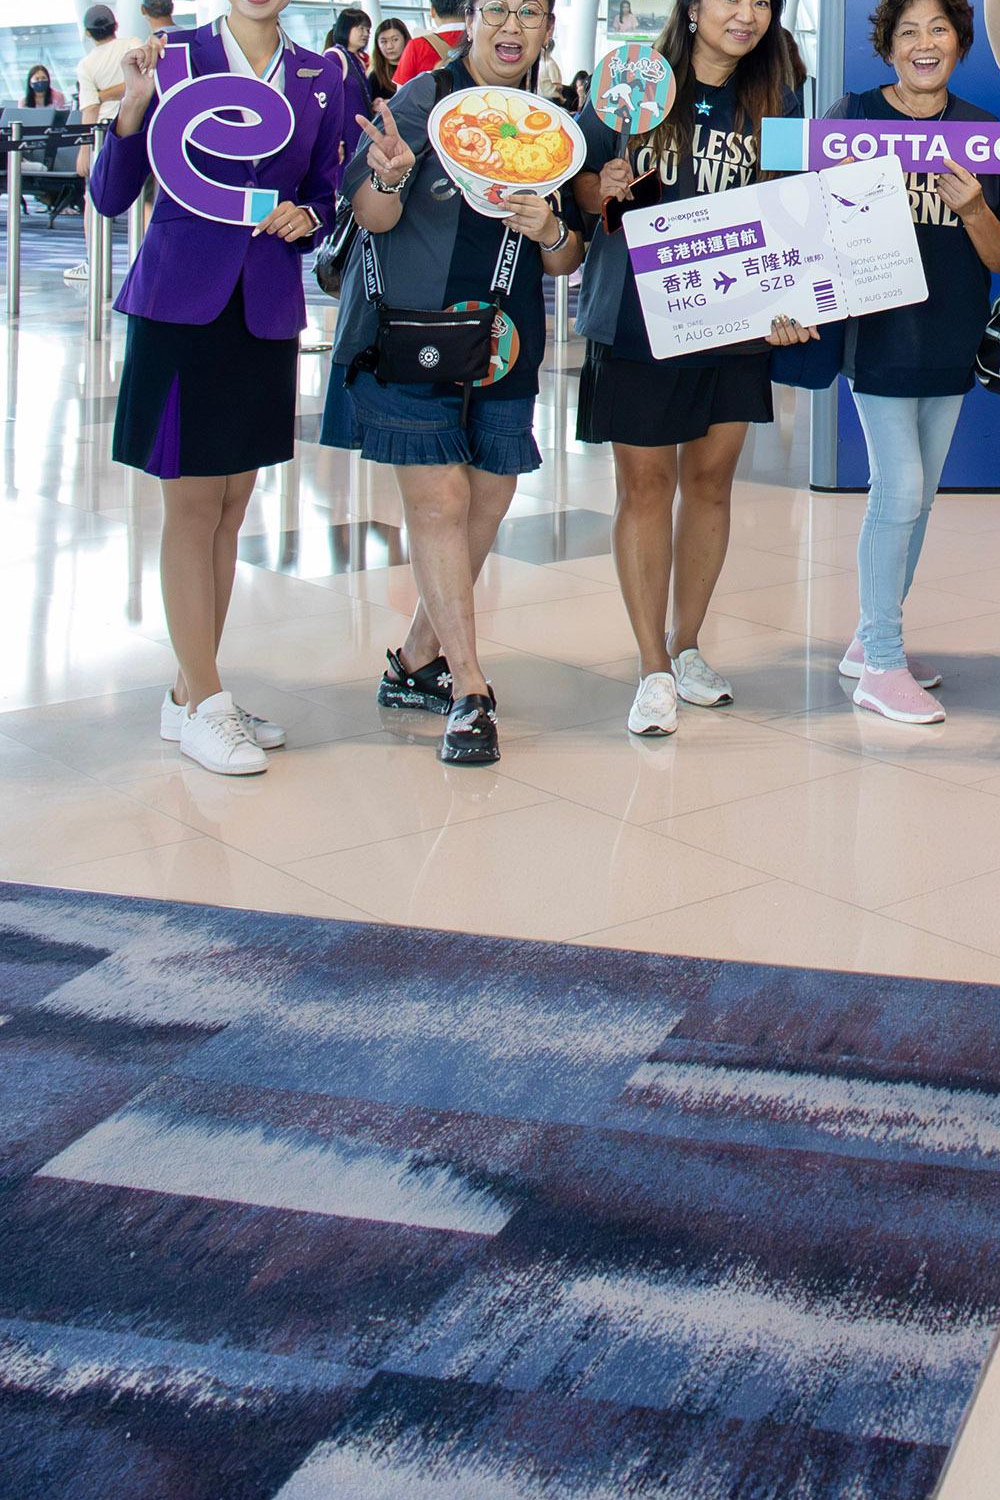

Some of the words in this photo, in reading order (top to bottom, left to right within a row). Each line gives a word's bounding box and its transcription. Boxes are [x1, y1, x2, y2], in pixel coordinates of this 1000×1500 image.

[822, 132, 951, 162] GOTTA
[656, 228, 758, 264] 香港快運首航
[846, 237, 872, 248] UO716
[497, 239, 517, 289] KIPLING
[850, 256, 876, 266] HONG
[877, 250, 900, 261] KONG
[853, 265, 879, 275] KUALA
[880, 257, 914, 270] LUMPUR
[365, 248, 377, 295] KIPLING
[662, 269, 702, 294] 香港
[741, 247, 802, 277] 吉隆坡
[855, 272, 893, 285] (SUBANG)
[759, 274, 796, 293] SZB
[667, 293, 707, 313] HKG
[864, 293, 881, 302] AUG
[883, 288, 903, 299] 2025
[674, 334, 681, 344] 1
[685, 327, 713, 342] AUG
[716, 319, 750, 335] 2025
